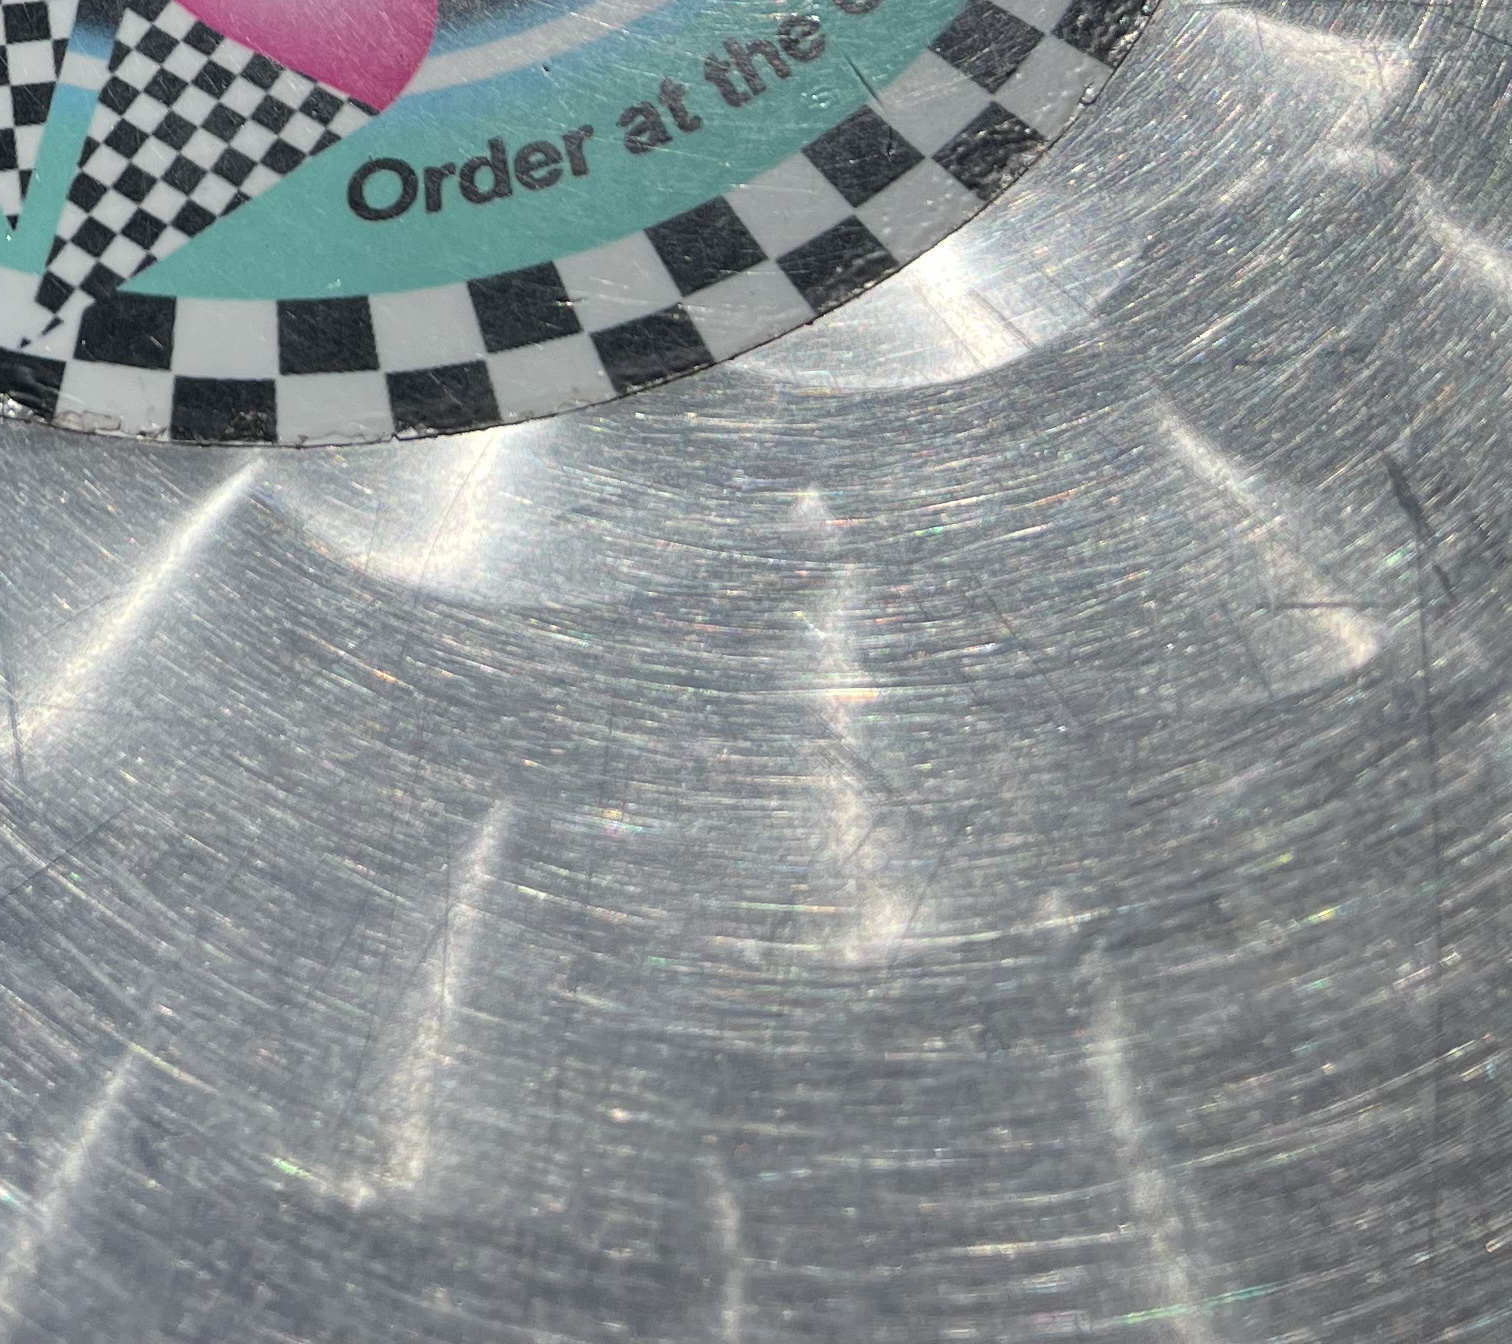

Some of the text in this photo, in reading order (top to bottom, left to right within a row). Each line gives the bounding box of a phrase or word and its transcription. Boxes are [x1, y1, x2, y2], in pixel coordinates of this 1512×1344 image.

[345, 123, 594, 221] Order
[616, 76, 704, 154] at
[702, 13, 827, 108] the
